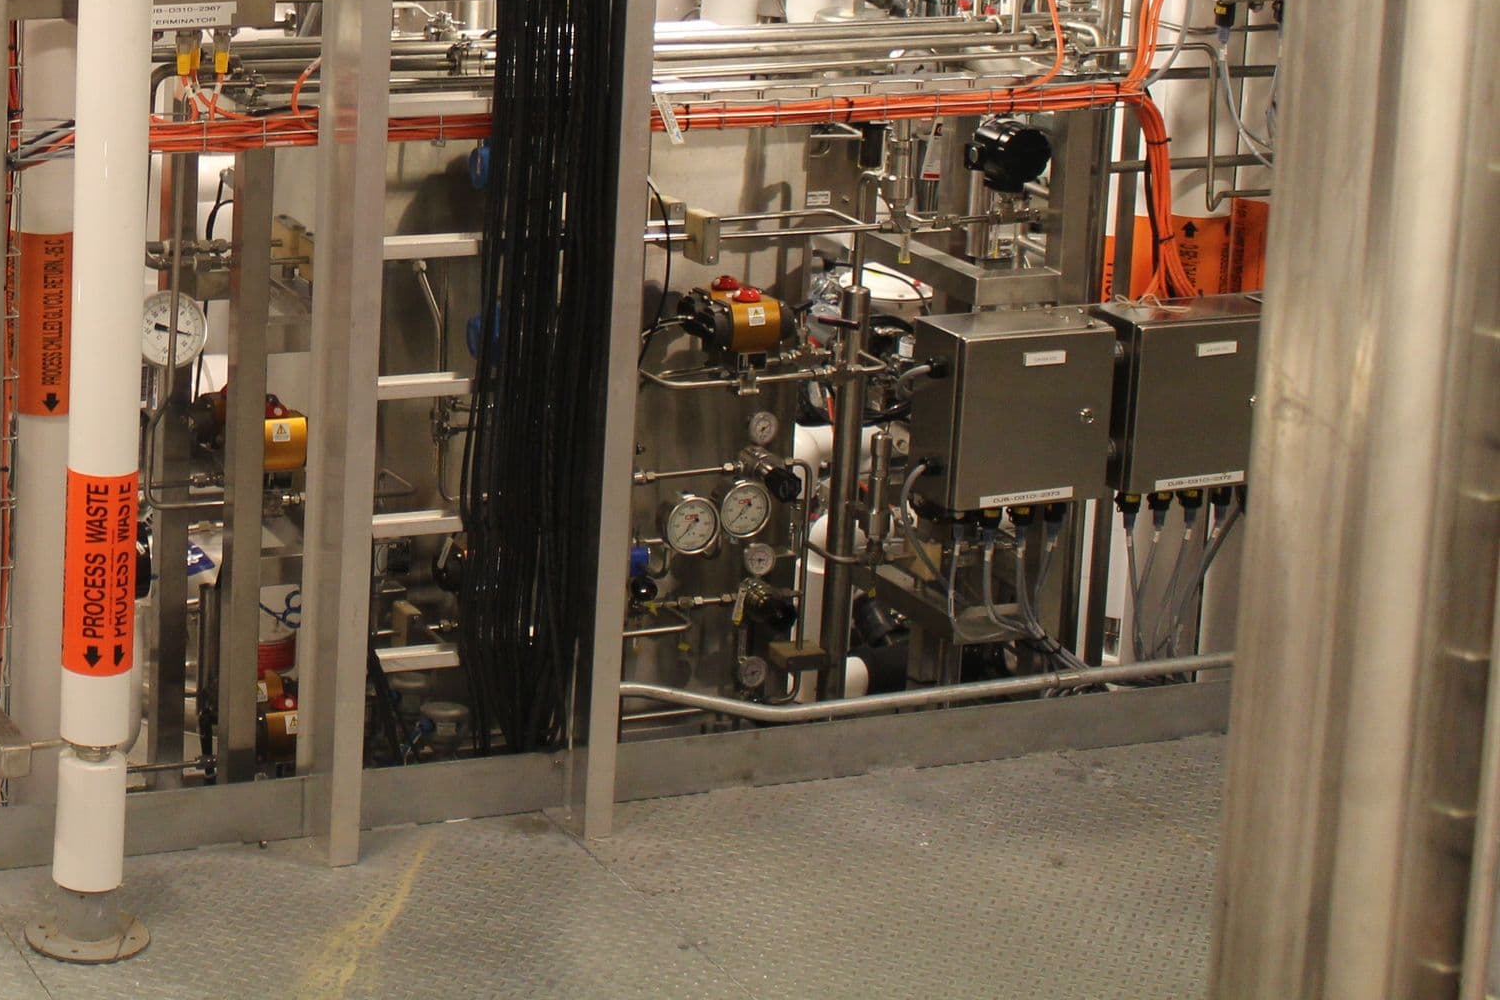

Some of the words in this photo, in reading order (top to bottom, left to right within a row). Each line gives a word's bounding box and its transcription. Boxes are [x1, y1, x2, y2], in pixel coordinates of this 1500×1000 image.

[153, 17, 217, 25] ERMINATOR
[43, 289, 64, 320] GLYCOL
[42, 321, 64, 352] CHILLED
[41, 352, 63, 386] PROCESS
[84, 483, 109, 544] WASTE
[116, 482, 132, 543] WASTE
[82, 552, 107, 639] PROCESS
[114, 551, 130, 638] PROCESS
